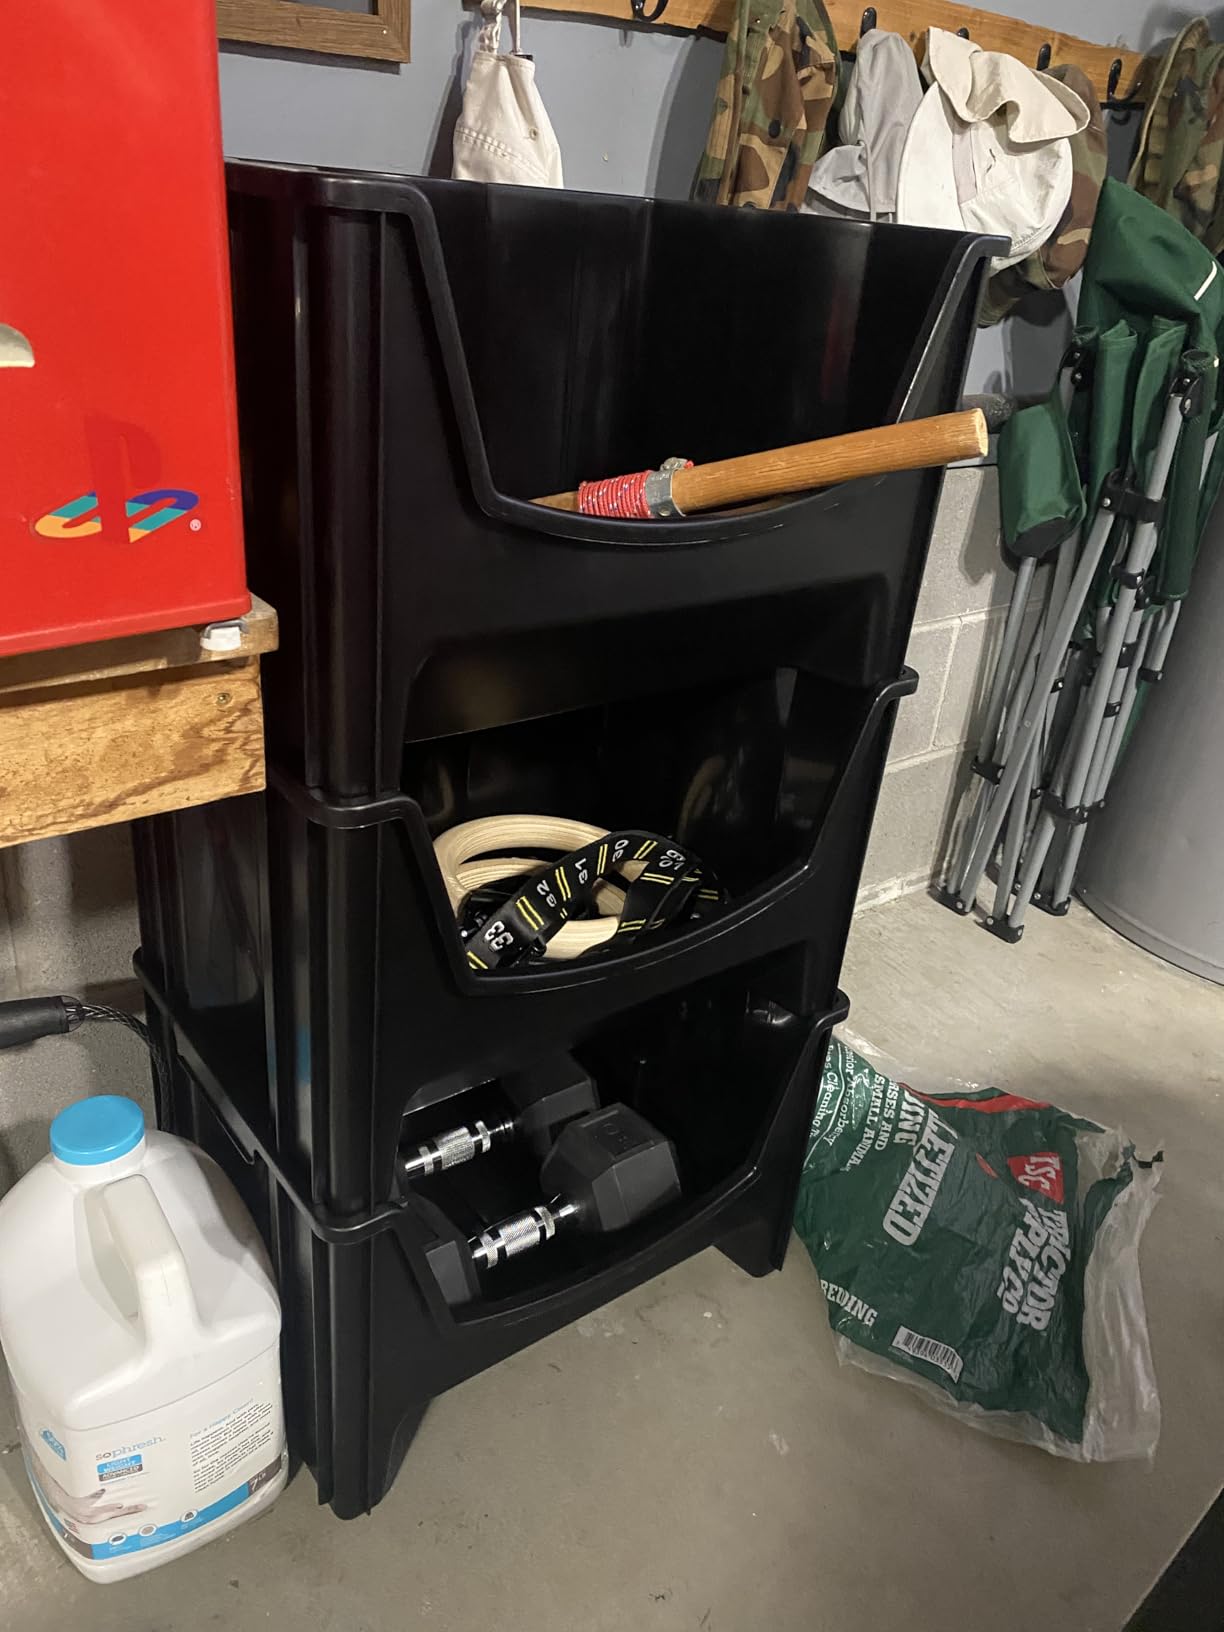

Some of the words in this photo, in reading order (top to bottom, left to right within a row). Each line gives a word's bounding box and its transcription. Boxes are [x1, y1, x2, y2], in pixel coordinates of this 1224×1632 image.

[612, 839, 629, 862] 30
[574, 858, 589, 884] 31
[536, 880, 558, 908] 32
[484, 921, 514, 951] 33
[866, 1074, 885, 1126] SMALL
[840, 1126, 876, 1171] ANIMA
[875, 1121, 893, 1150] AND
[1018, 1156, 1061, 1190] TSC
